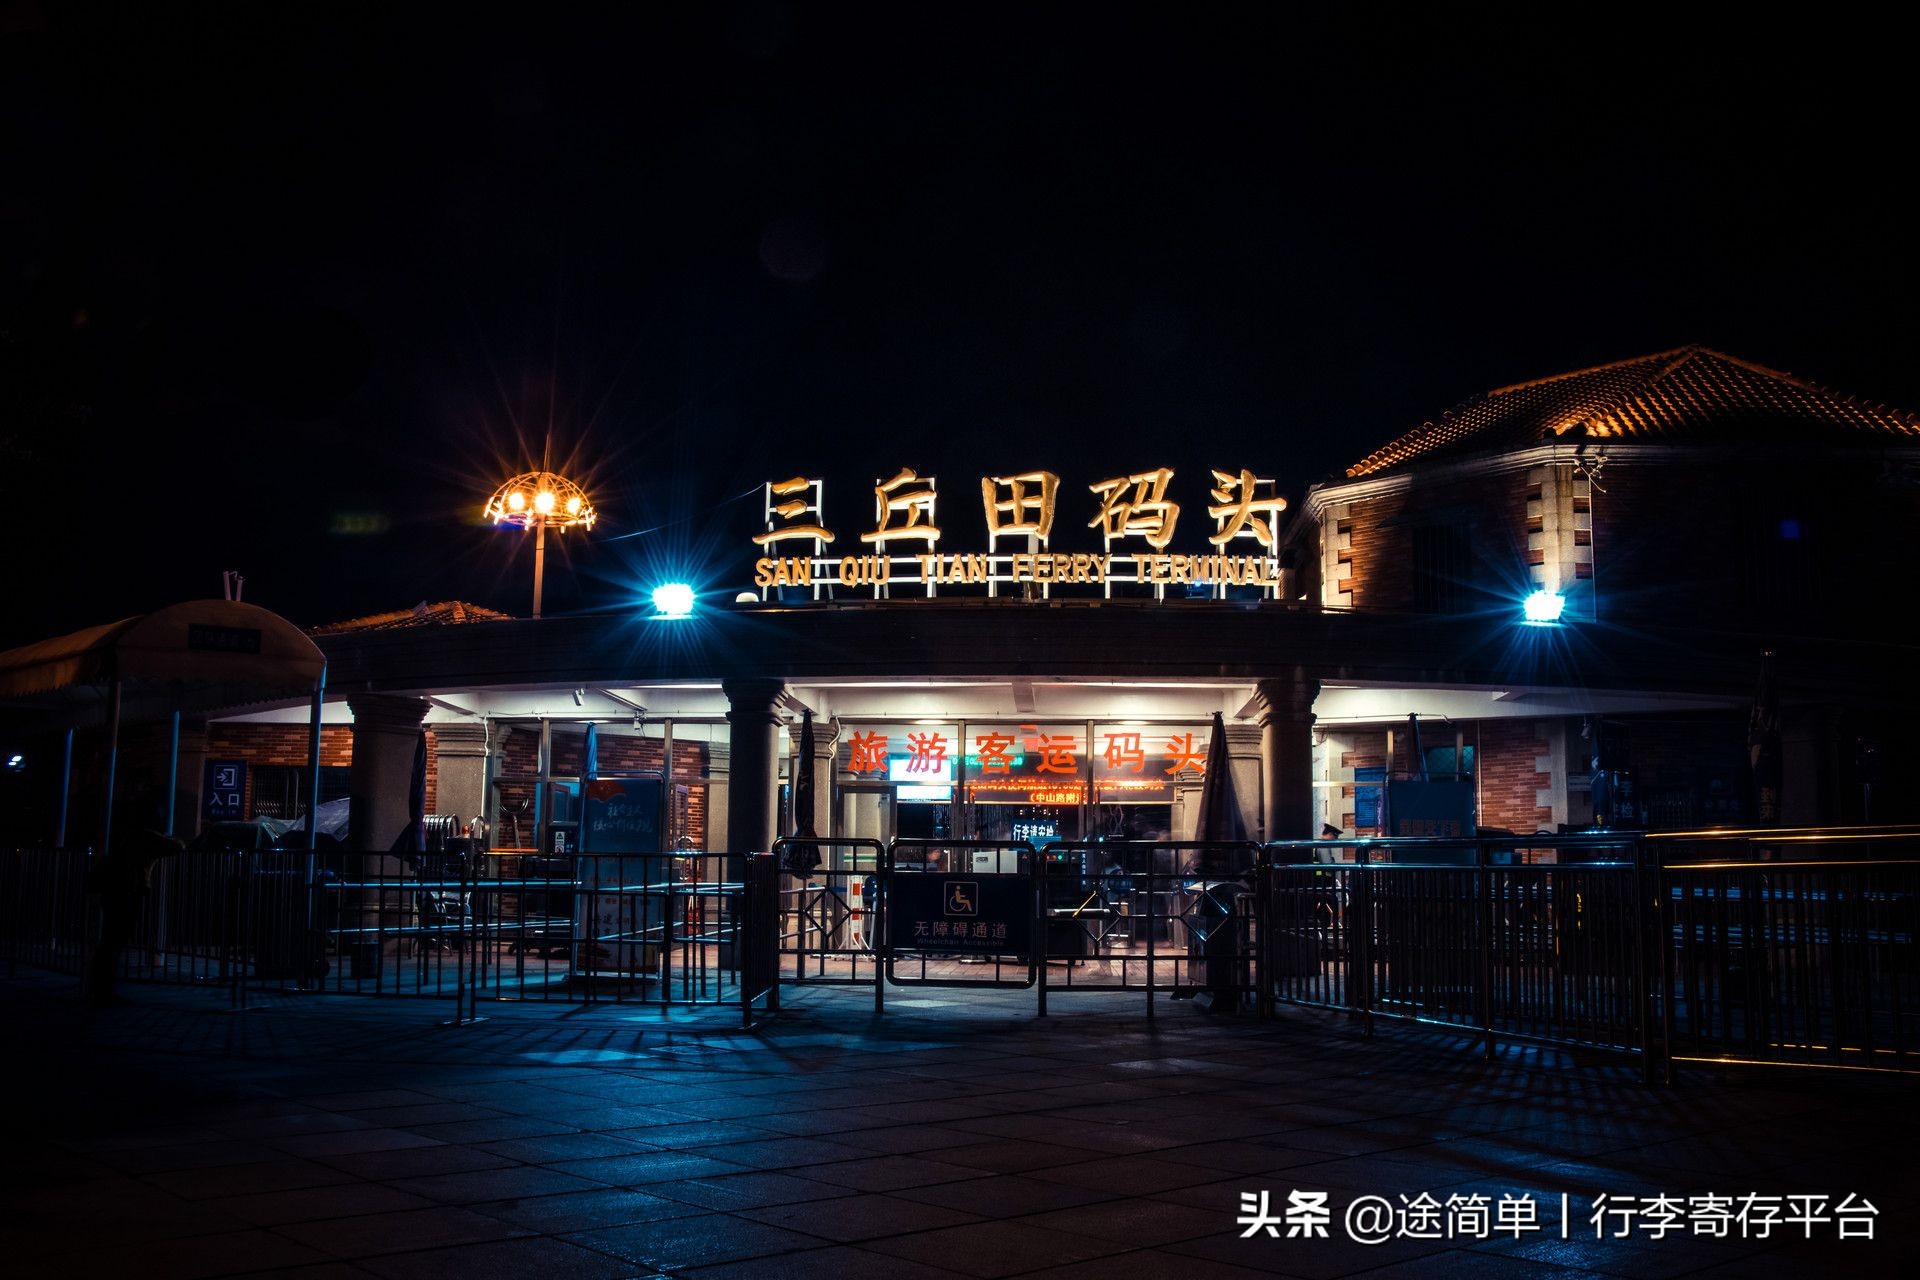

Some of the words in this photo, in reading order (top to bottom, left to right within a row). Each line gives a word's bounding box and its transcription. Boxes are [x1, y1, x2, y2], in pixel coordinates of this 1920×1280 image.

[752, 467, 1288, 548] 三丘田码头
[754, 556, 811, 587] SAN
[839, 556, 892, 588] QIU
[917, 552, 988, 584] TIAN
[1012, 553, 1109, 583] FERRY
[1131, 553, 1279, 586] TERMINAL
[848, 730, 1207, 775] 旅游客运码头
[209, 792, 239, 808] 入口
[914, 921, 1009, 939] 无障碍通道
